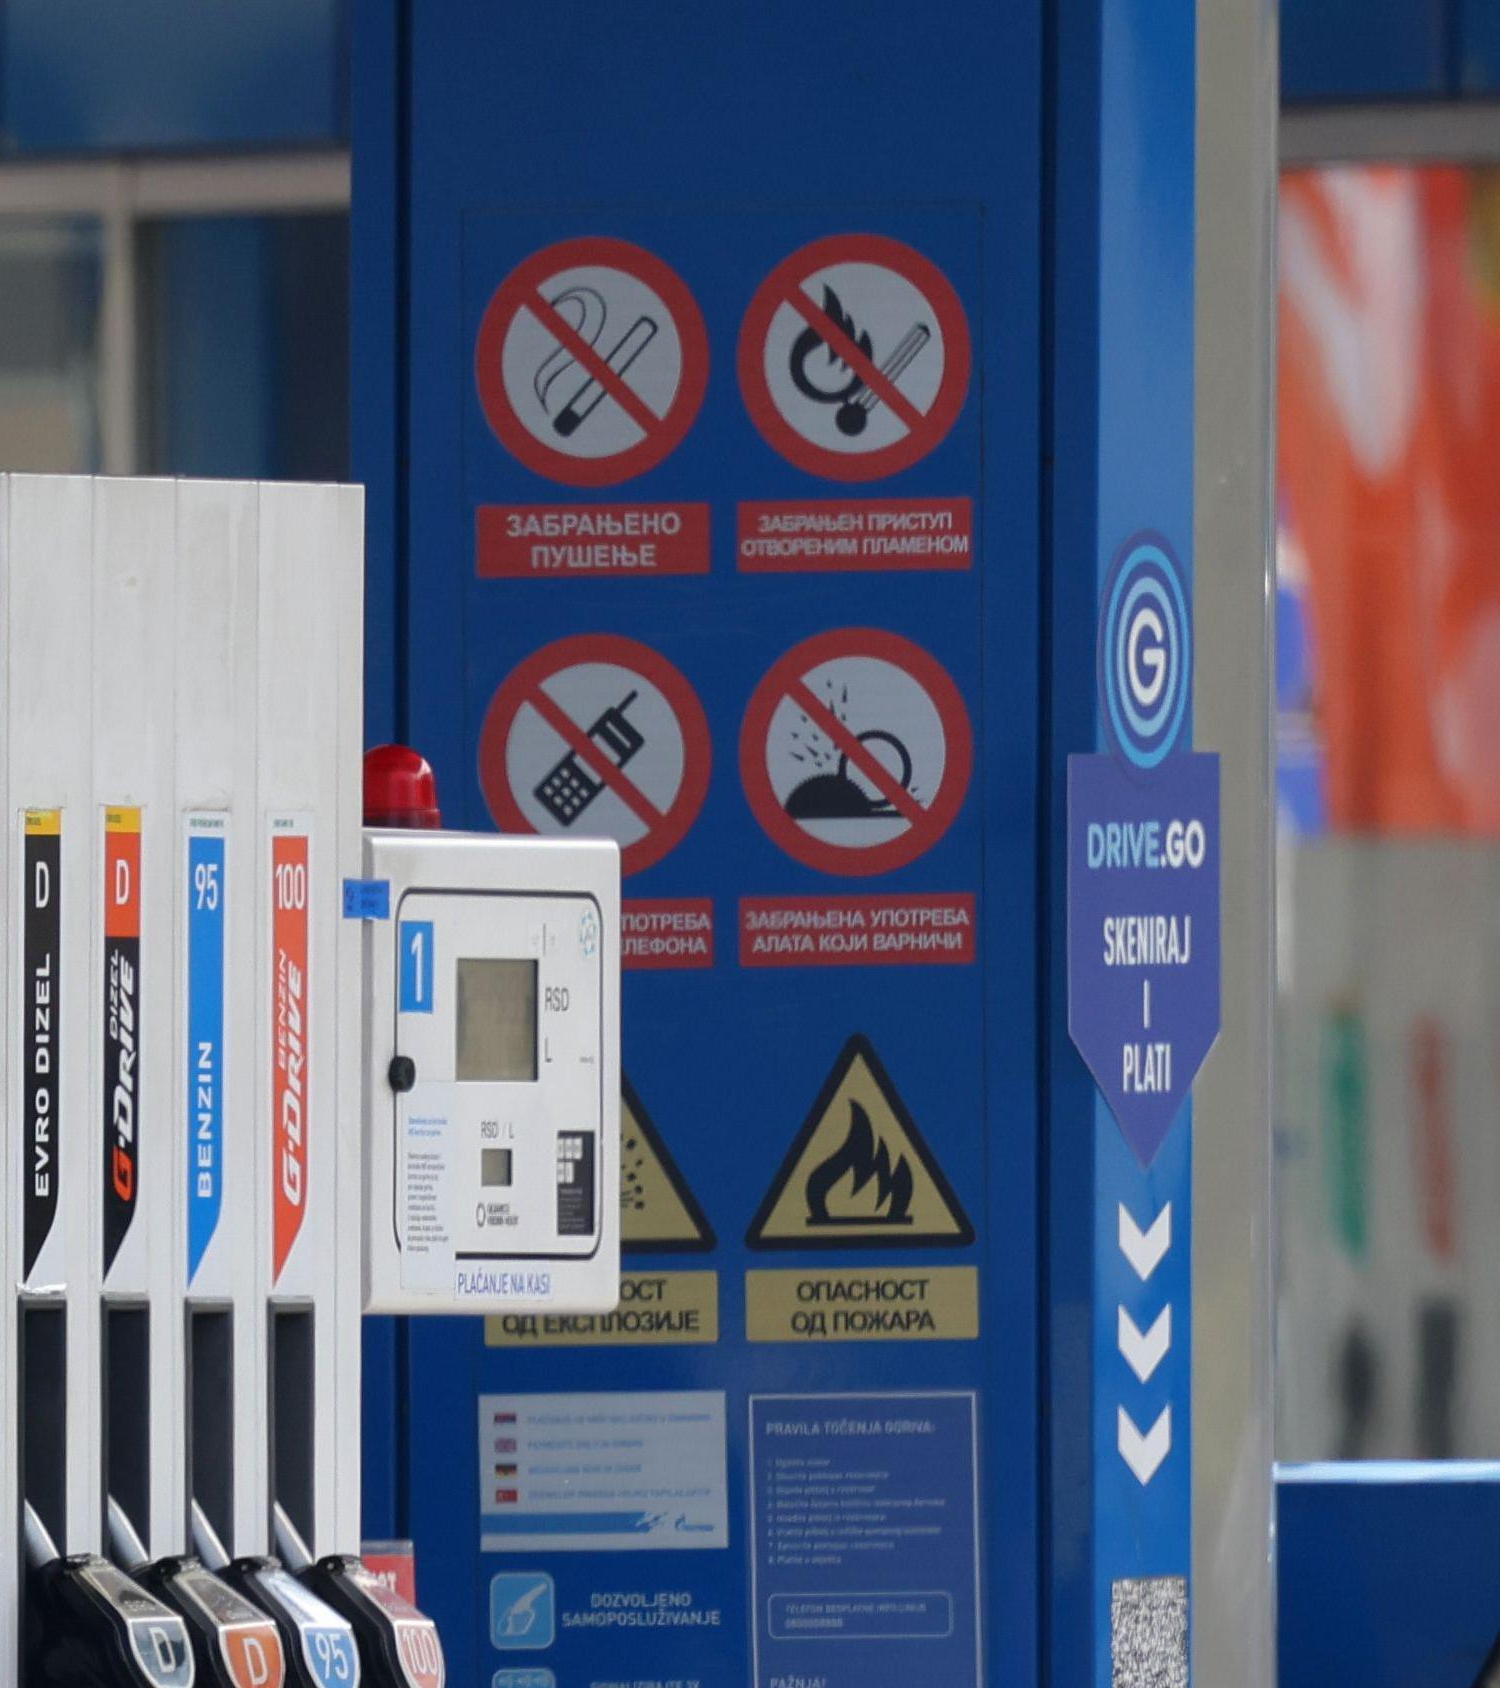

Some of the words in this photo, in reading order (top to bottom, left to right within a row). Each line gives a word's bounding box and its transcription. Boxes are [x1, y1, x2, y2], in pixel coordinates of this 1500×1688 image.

[507, 513, 682, 537] ЗАБРАЊЕНО
[757, 514, 864, 534] ЗАБРАЊЕН
[868, 512, 953, 531] ПРИСТУП
[532, 544, 657, 569] ПУШЕЊЕ
[740, 536, 858, 558] ОТВОРЕНИМ
[862, 535, 969, 556] ПЛАМЕНОМ
[1087, 820, 1205, 869] DRIVE.GO
[35, 861, 49, 908] D
[115, 860, 129, 905] D
[195, 864, 218, 910] 95
[275, 864, 304, 909] 100
[621, 913, 711, 932] ПОТРЕБА
[745, 910, 864, 930] ЗАБРАЊЕНА
[869, 908, 970, 927] УПОТРЕБА
[1103, 916, 1191, 965] SKENIRAJ
[624, 937, 707, 956] ЛЕФОНА
[753, 935, 815, 954] АЛАТА
[818, 934, 869, 953] КОЈИ
[873, 932, 963, 951] ВАРНИЧИ
[411, 932, 423, 1002] 1
[34, 953, 50, 1074] DIZEL
[545, 987, 569, 1012] RSD
[1142, 979, 1150, 1028] I
[1123, 1042, 1172, 1093] PLATI
[198, 1041, 213, 1198] BENZIN
[34, 1090, 50, 1197] EVRO
[796, 1279, 930, 1300] ОПАСНОСТ
[791, 1312, 829, 1336] ОД
[832, 1309, 936, 1332] ПОЖАРА
[148, 1626, 177, 1673] D
[243, 1637, 268, 1686] D
[315, 1631, 347, 1680] 95
[402, 1624, 438, 1676] 100
